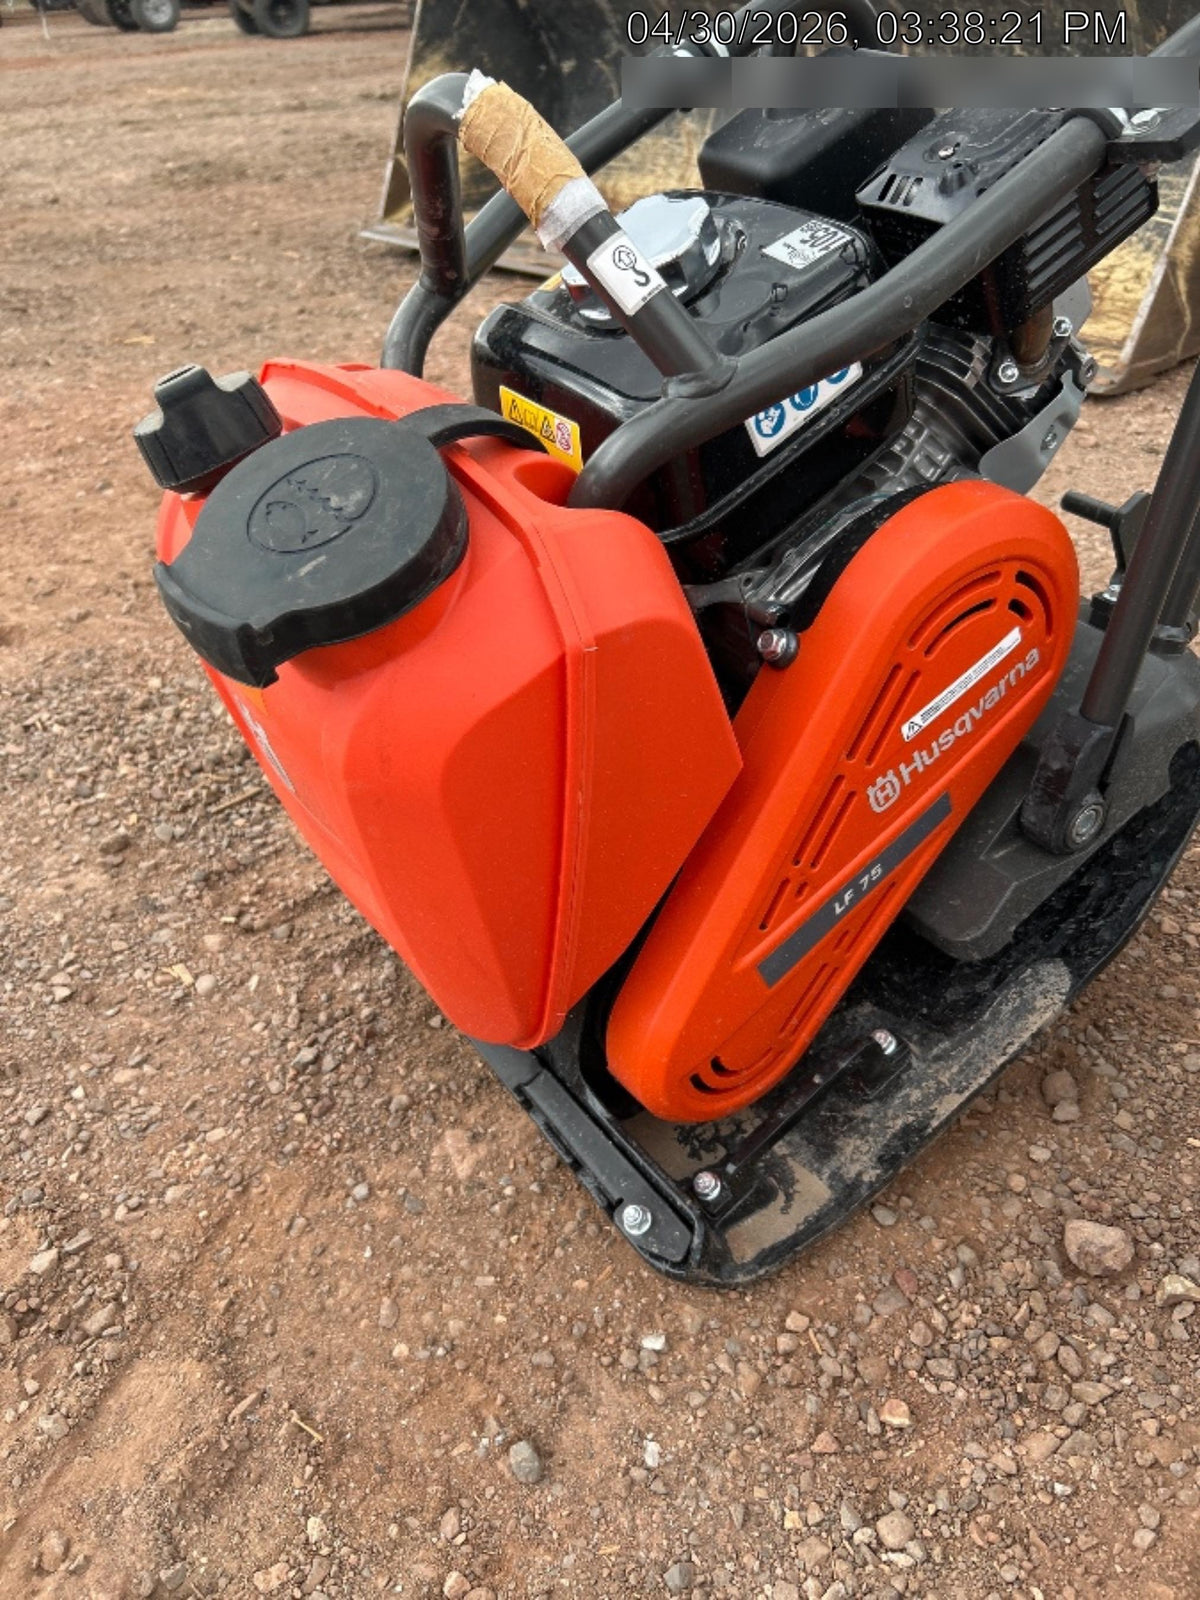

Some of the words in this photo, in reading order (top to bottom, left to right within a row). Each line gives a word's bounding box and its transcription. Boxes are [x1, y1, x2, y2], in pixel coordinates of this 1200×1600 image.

[899, 647, 1040, 785] Husqvarna
[834, 889, 855, 915] LF
[859, 864, 883, 891] 75
